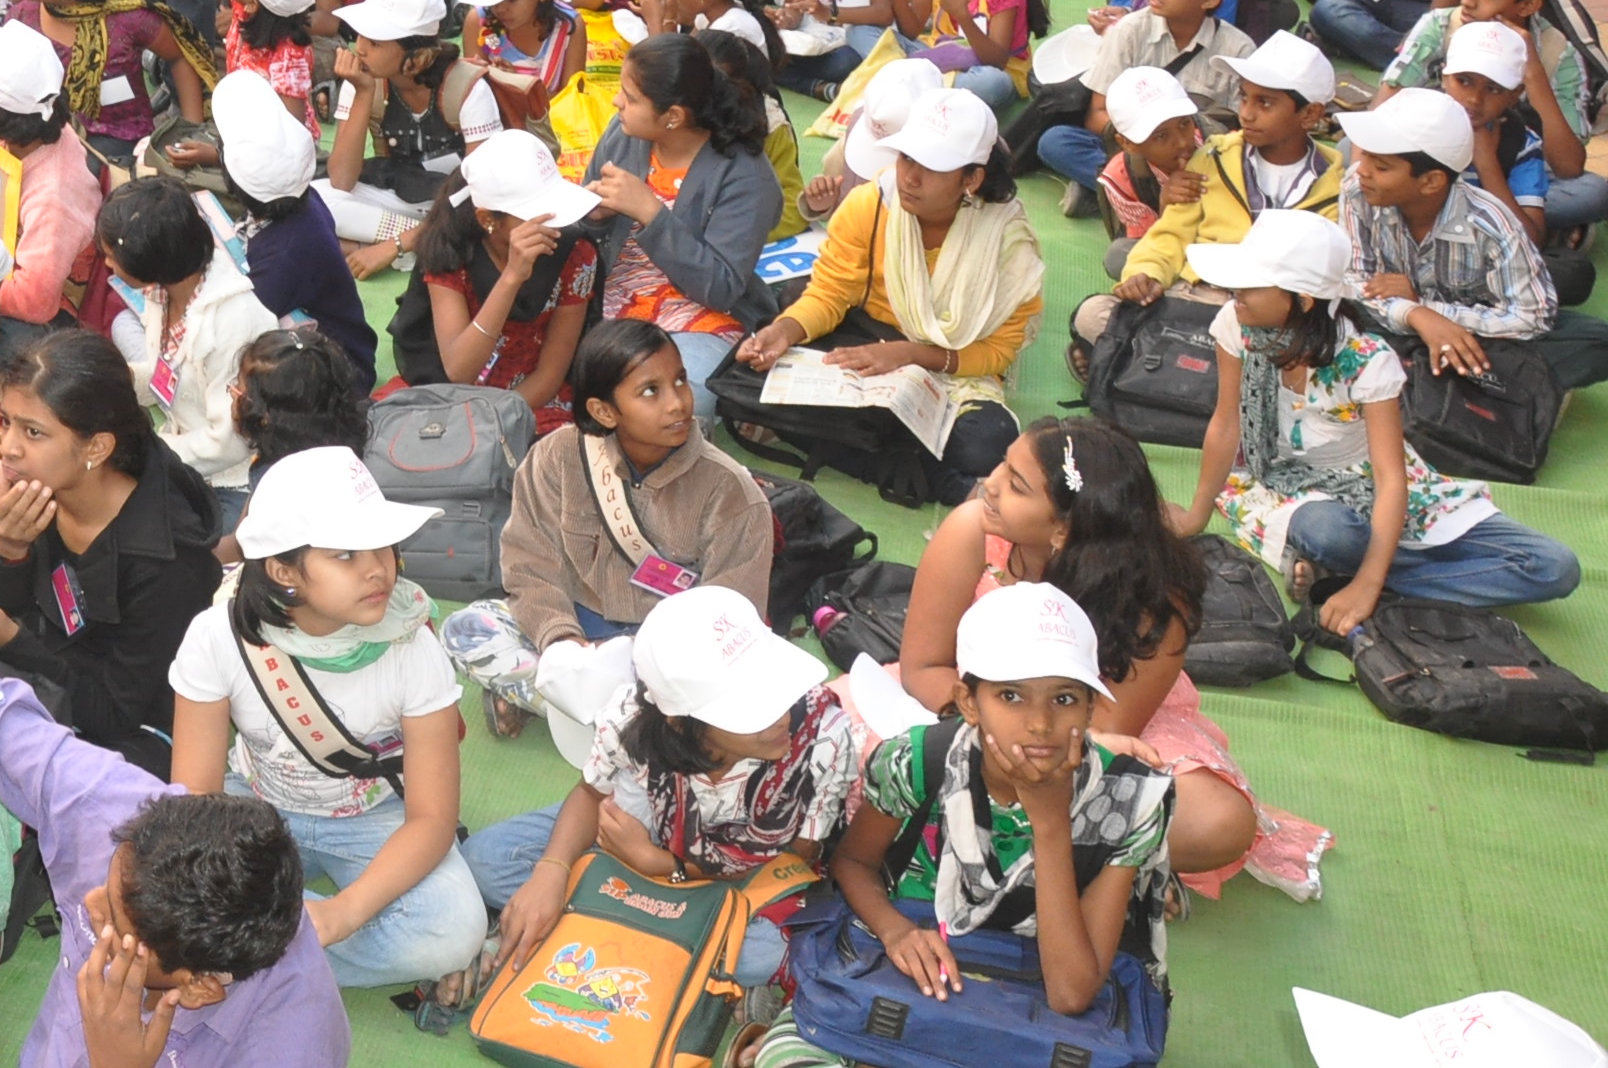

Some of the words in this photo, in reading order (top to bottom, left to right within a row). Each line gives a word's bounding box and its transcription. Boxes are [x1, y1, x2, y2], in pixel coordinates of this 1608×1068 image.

[593, 442, 642, 552] Abacus
[1042, 598, 1071, 625] SK
[712, 612, 739, 642] SK
[1037, 622, 1078, 640] ABACUS
